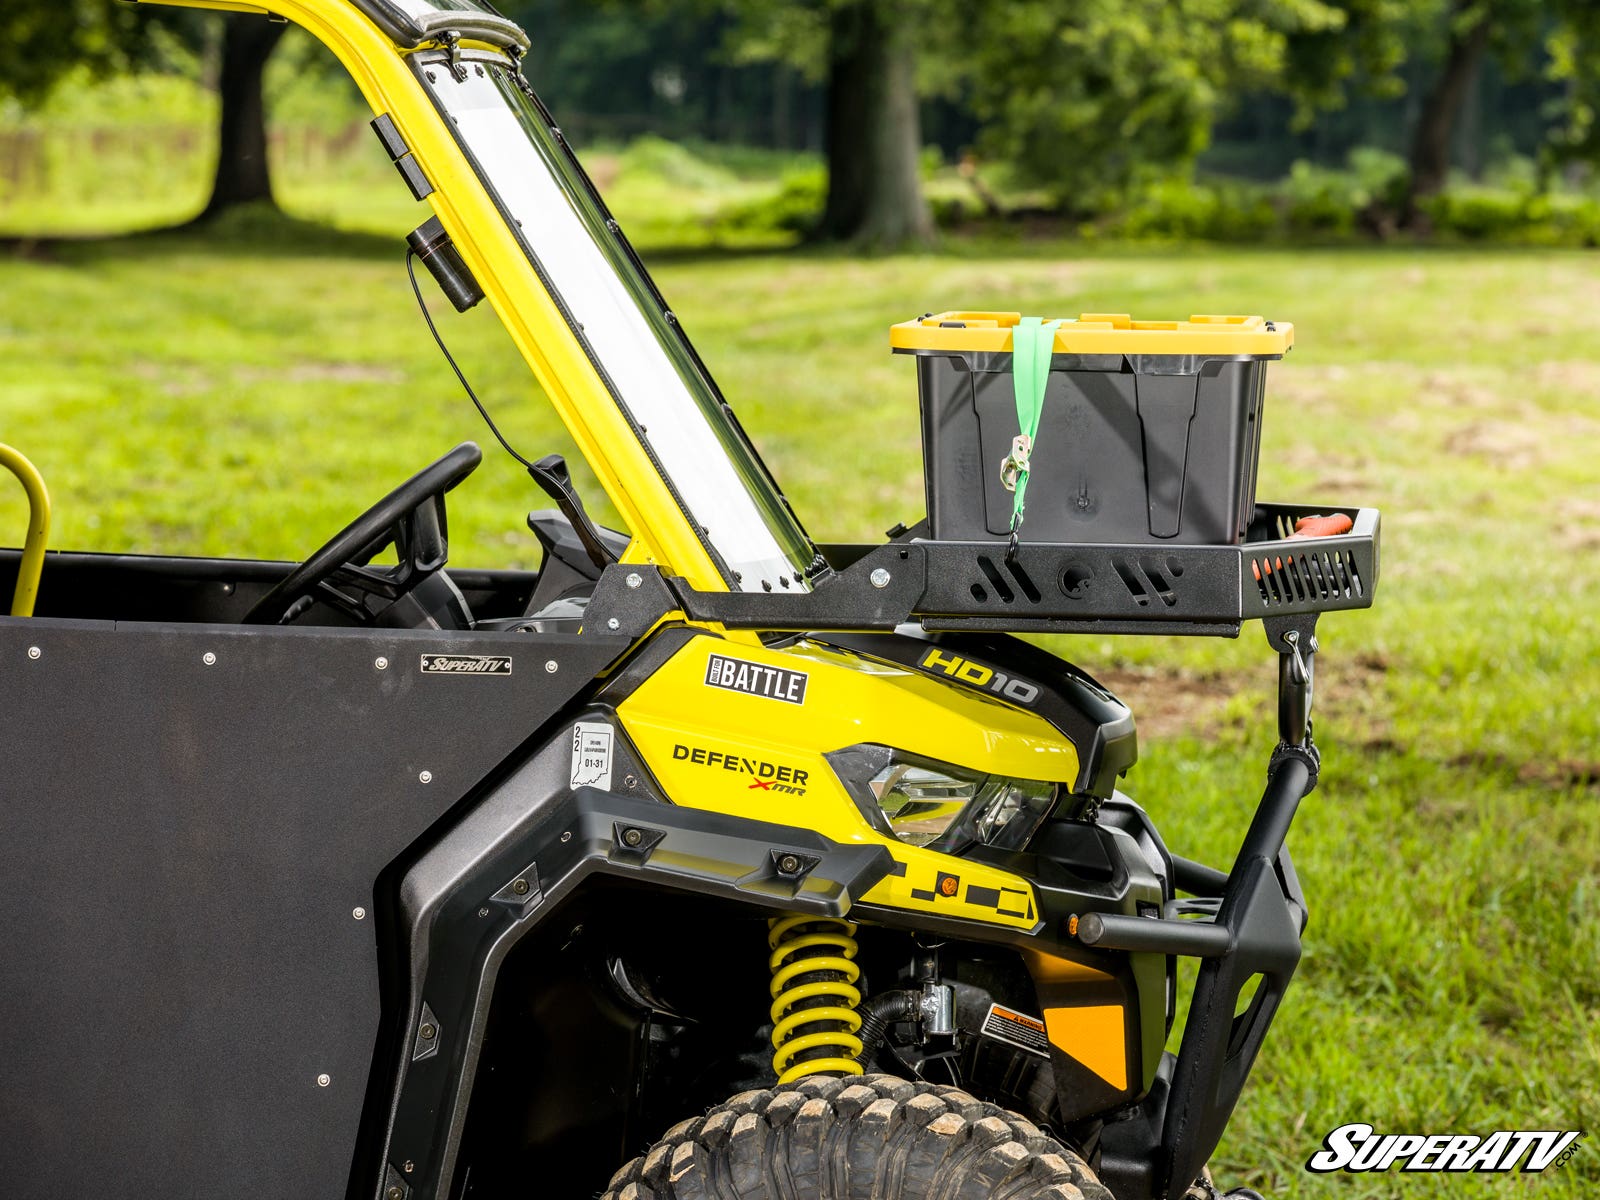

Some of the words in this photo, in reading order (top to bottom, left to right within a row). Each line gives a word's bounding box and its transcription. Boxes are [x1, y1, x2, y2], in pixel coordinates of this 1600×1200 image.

[428, 657, 505, 672] SUPERATV
[720, 659, 802, 701] BATTLE
[922, 649, 1039, 703] HD10
[584, 758, 603, 768] 01-31
[673, 744, 809, 786] DEFENDER
